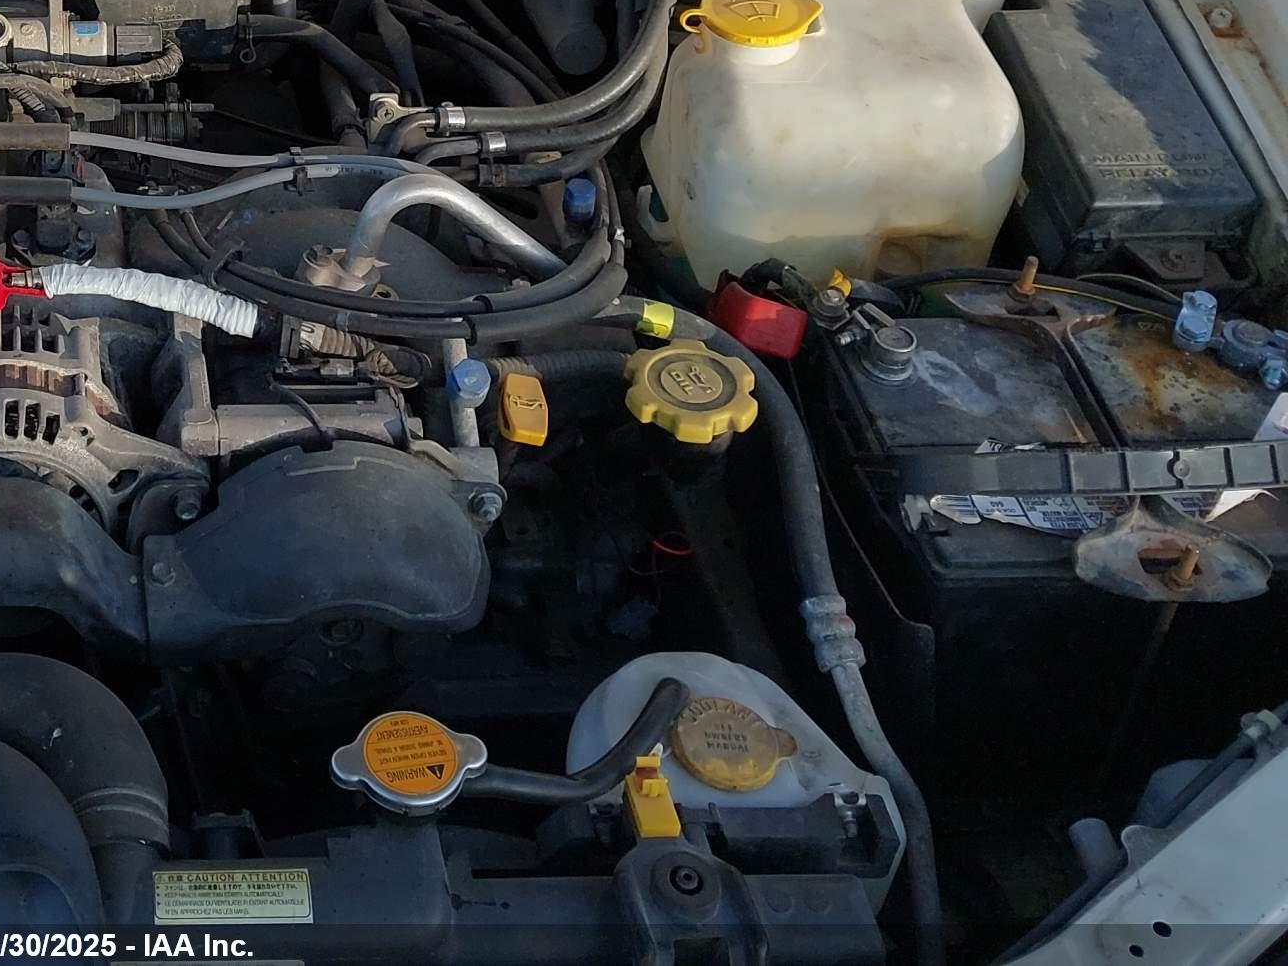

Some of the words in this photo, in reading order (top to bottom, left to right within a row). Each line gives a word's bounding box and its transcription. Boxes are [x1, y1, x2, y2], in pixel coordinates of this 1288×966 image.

[1093, 153, 1151, 164] MAIN
[669, 371, 694, 394] OIL
[706, 742, 750, 753] MANUAL
[386, 766, 428, 783] WARNING
[242, 873, 304, 882] ATTENTION
